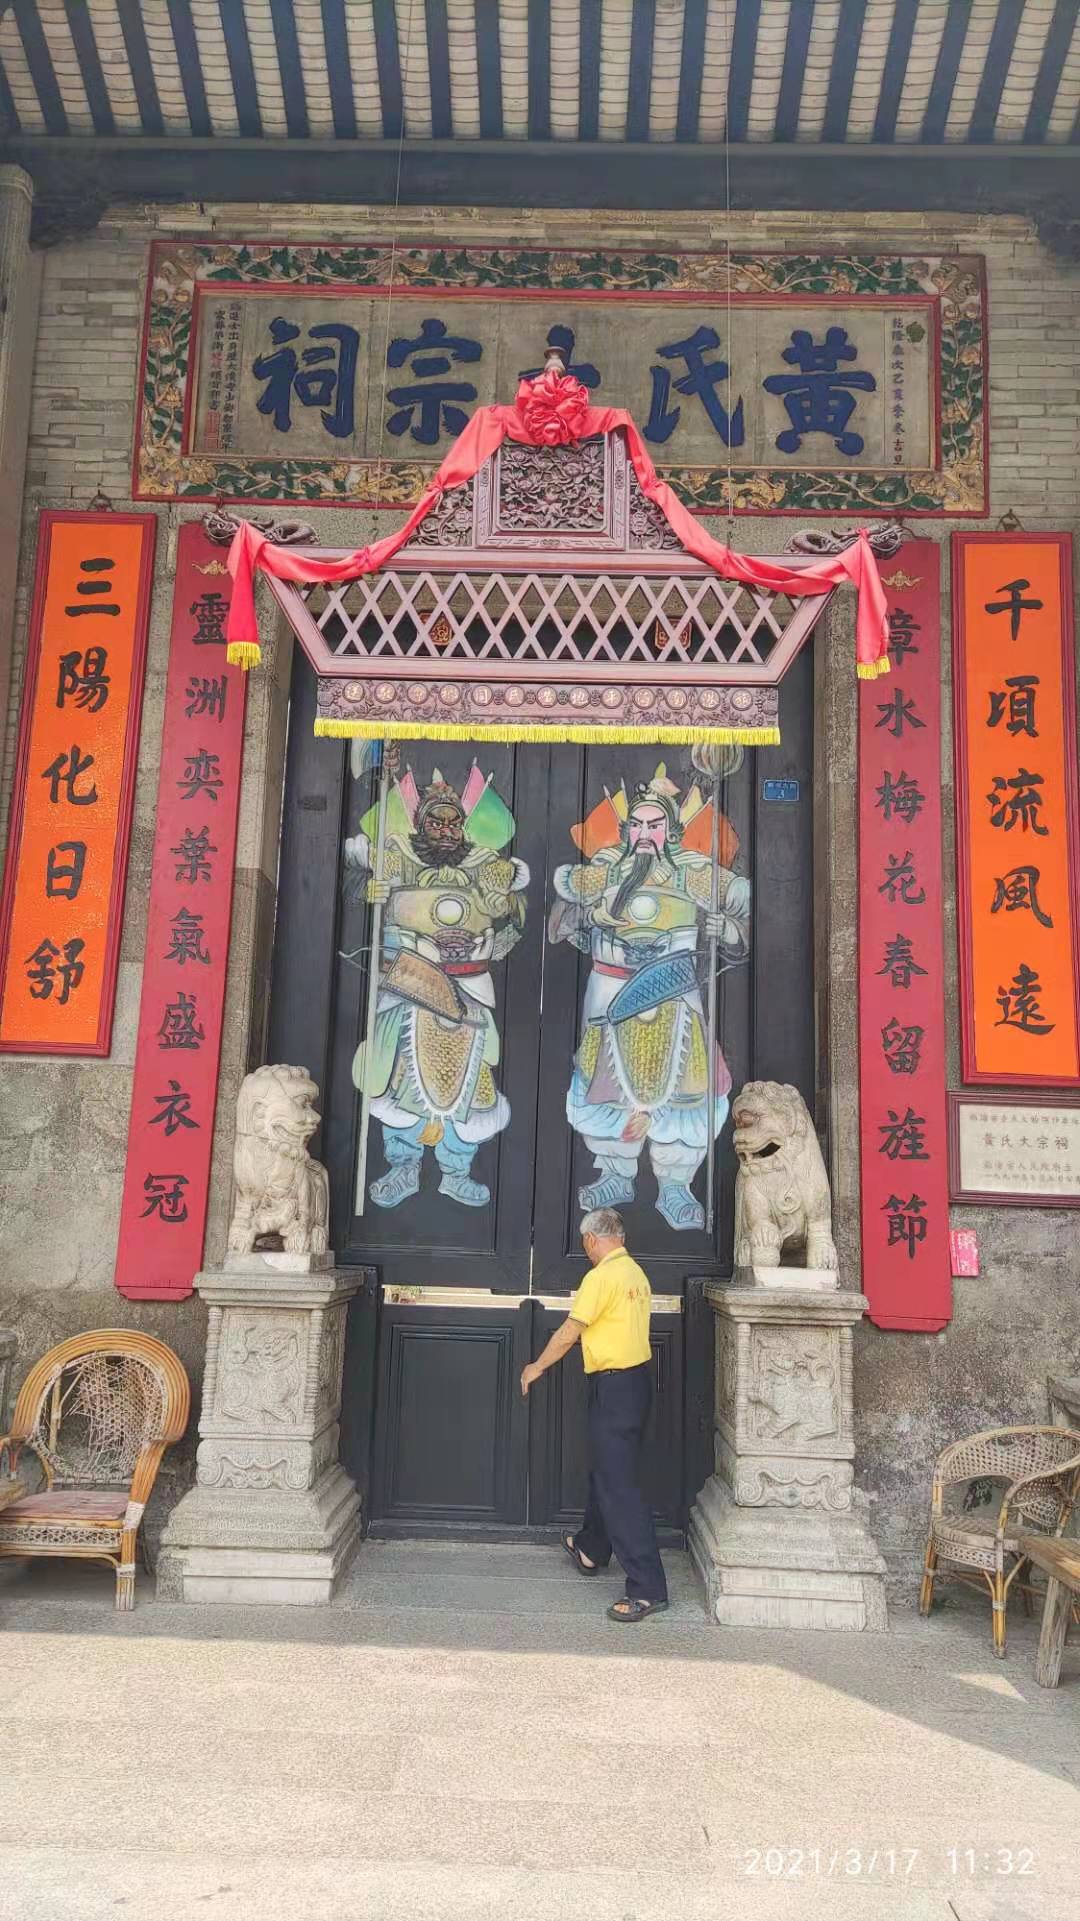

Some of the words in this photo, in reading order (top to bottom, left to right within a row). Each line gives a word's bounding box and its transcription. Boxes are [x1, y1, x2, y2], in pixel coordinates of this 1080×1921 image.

[23, 557, 120, 1005] 三陽化日舒
[138, 593, 231, 1223] 靈洲奕葉氣盛衣冠
[984, 578, 1056, 1037] 千頃流風遠
